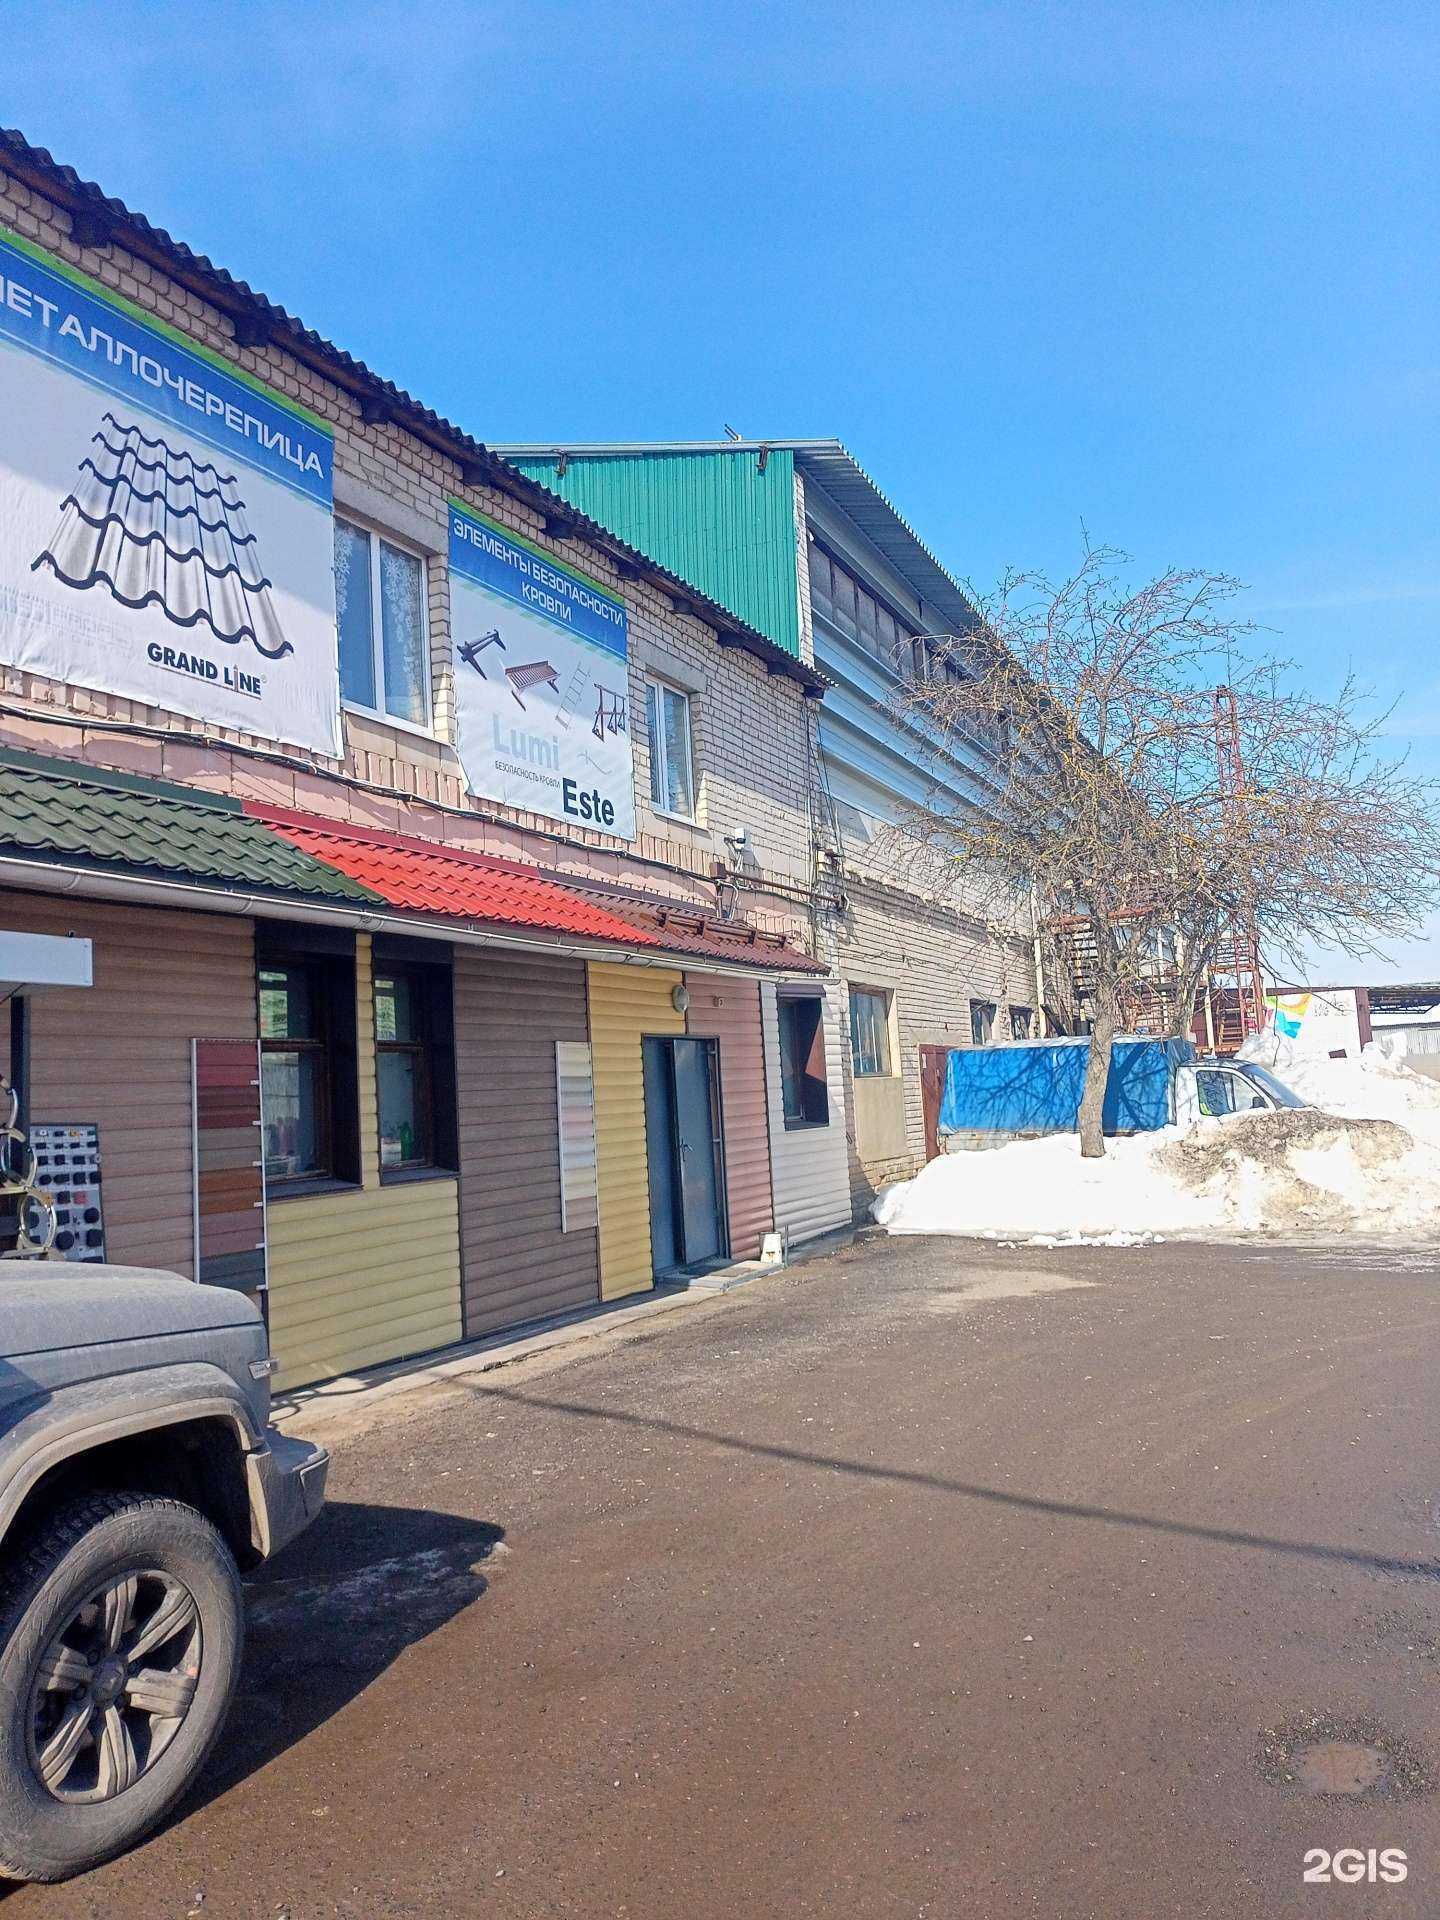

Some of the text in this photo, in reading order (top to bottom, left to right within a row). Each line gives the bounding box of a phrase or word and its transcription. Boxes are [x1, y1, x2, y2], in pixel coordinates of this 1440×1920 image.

[0, 275, 324, 478] ЕТАЛЛОЧЕРЕПИЦА
[453, 518, 623, 627] ЭЛЕМЕНТЫ БЕЗОПАСНОСТИ
[521, 581, 572, 622] КРОВЛИ
[147, 642, 262, 695] GRAND LINE
[493, 712, 559, 771] Lumi
[495, 760, 539, 782] БЕЗОПАСНОСТЬ
[563, 777, 615, 825] Este
